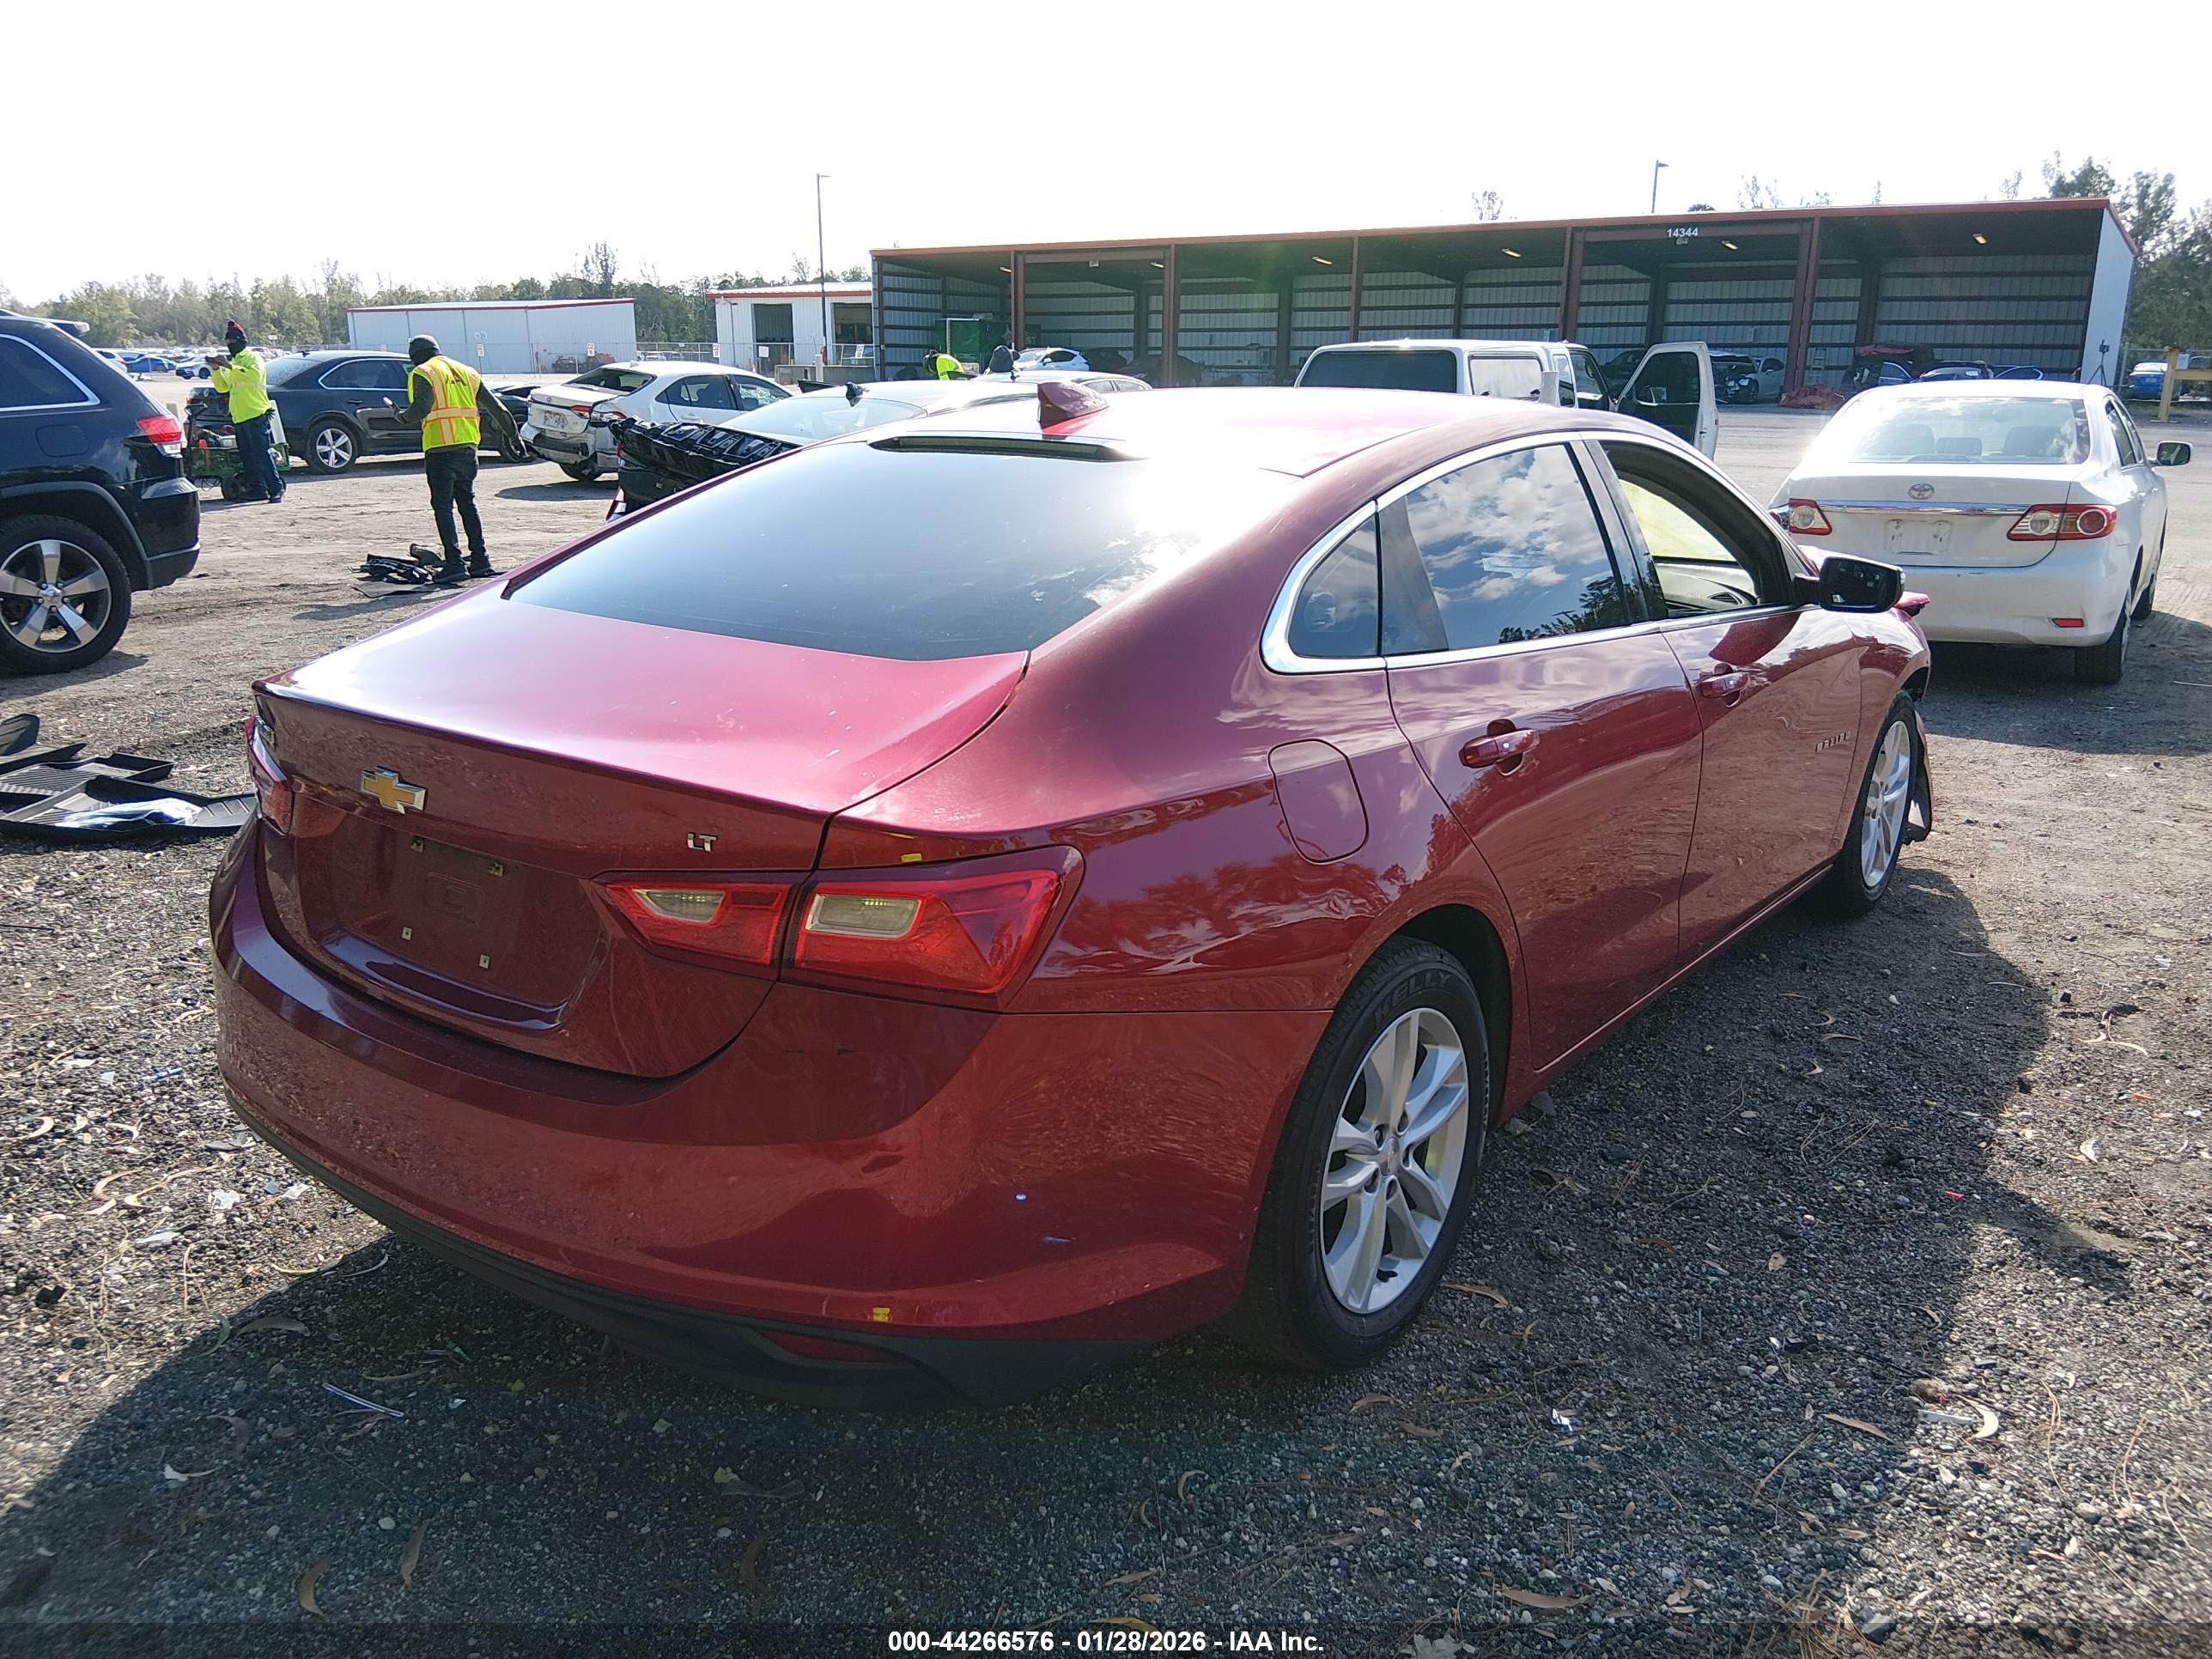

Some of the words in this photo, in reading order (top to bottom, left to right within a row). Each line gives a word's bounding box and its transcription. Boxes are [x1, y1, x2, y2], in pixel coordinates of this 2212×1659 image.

[1666, 227, 1699, 238] 14344
[1815, 730, 1851, 753] MALIBU
[687, 832, 717, 853] LT
